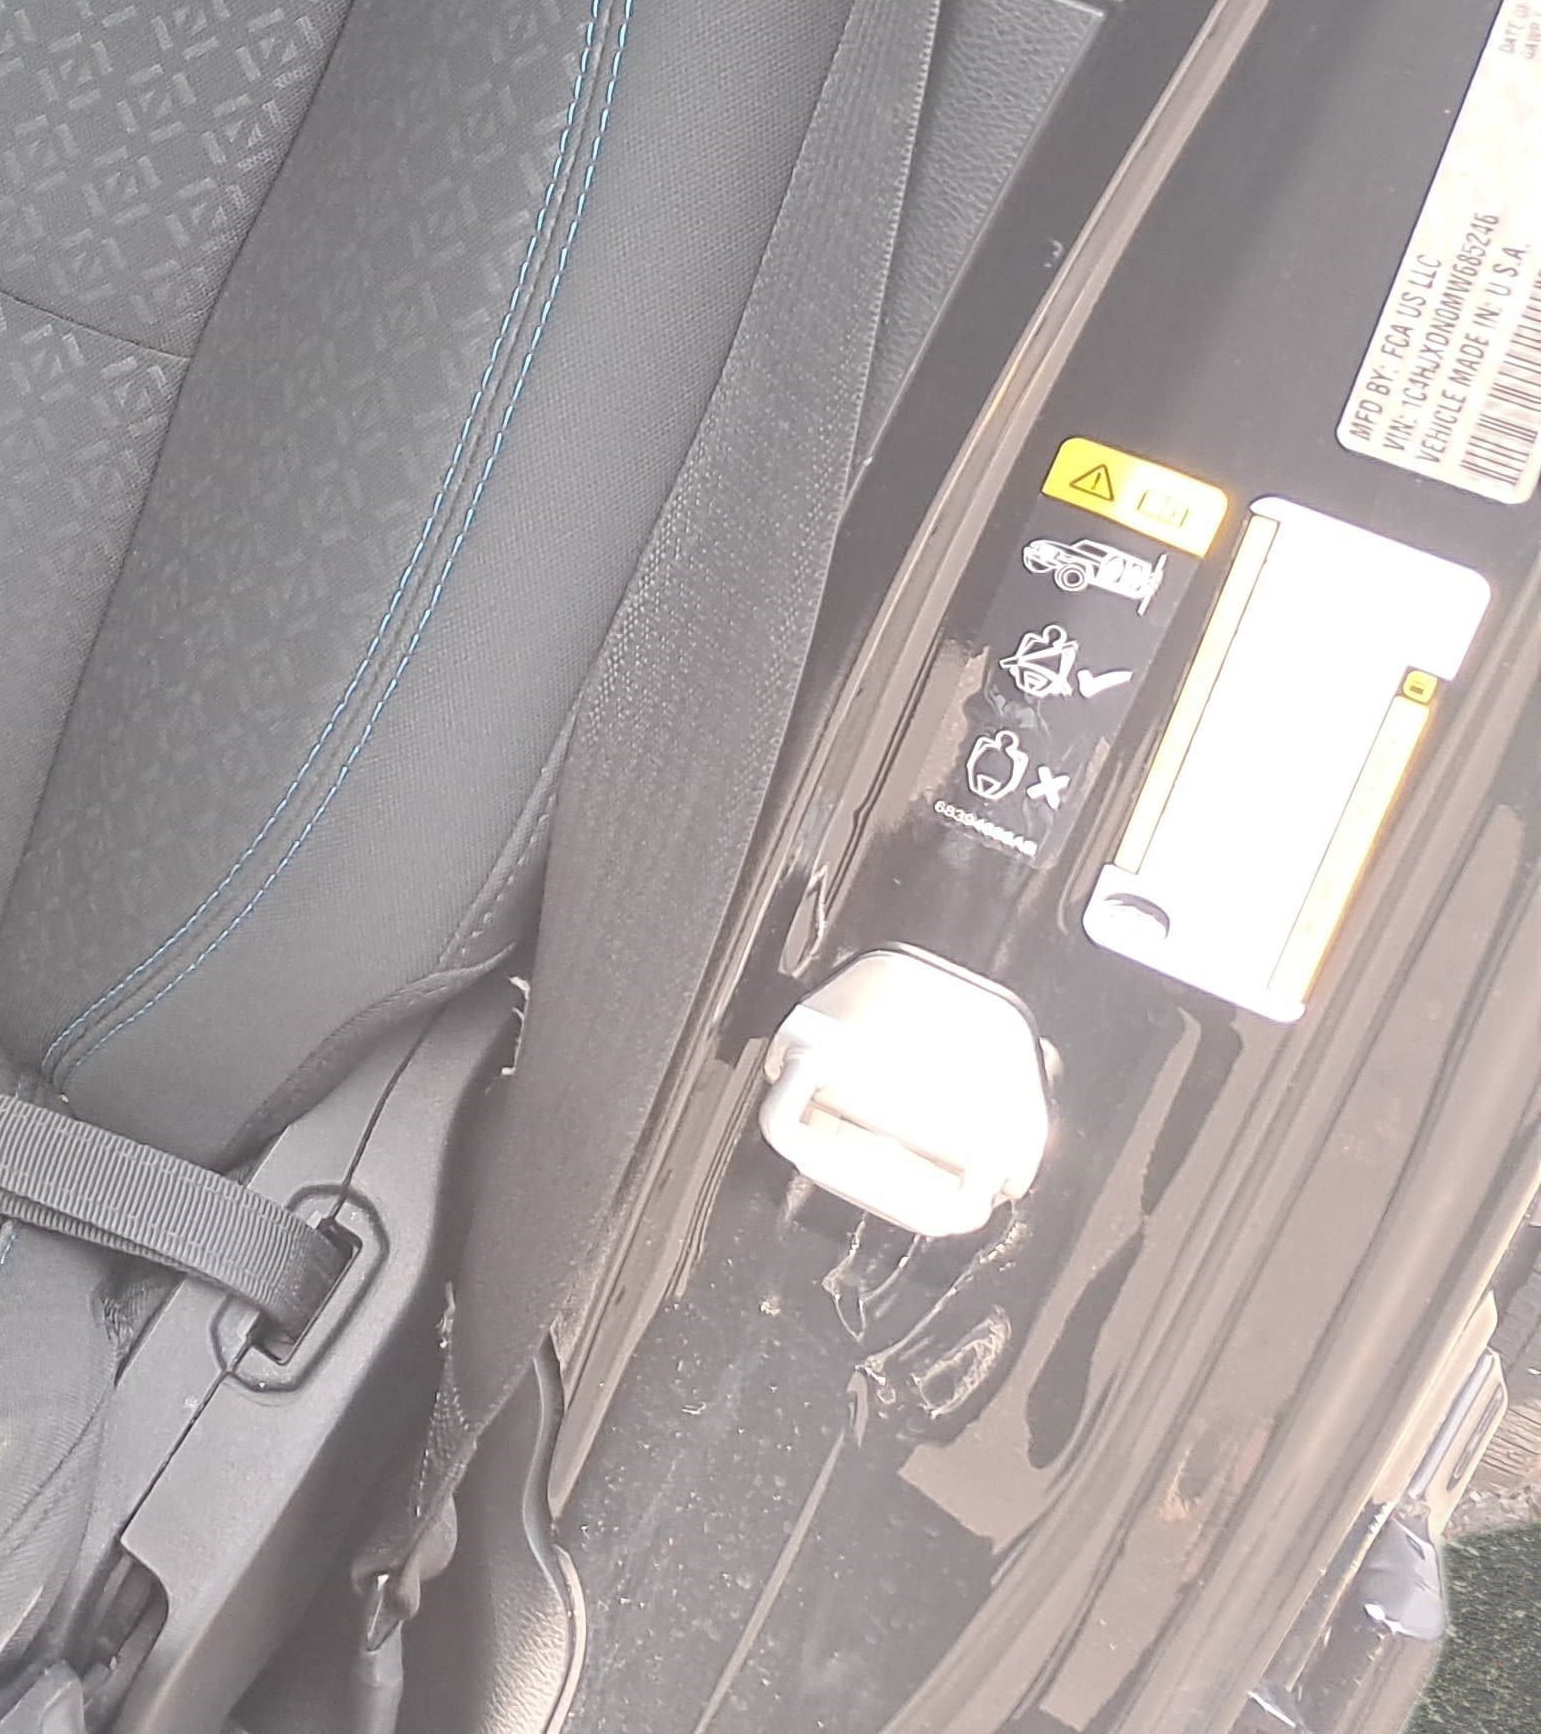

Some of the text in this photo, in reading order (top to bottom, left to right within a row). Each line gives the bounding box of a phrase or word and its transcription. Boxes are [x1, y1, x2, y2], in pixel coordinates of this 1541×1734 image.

[1408, 253, 1442, 290] LLC
[1397, 291, 1427, 318] US
[1381, 323, 1415, 359] FCA
[1417, 389, 1467, 464] VEHICLE
[1448, 332, 1490, 387] MADE
[1349, 399, 1384, 441] MFD
[1383, 414, 1418, 451] VIN:
